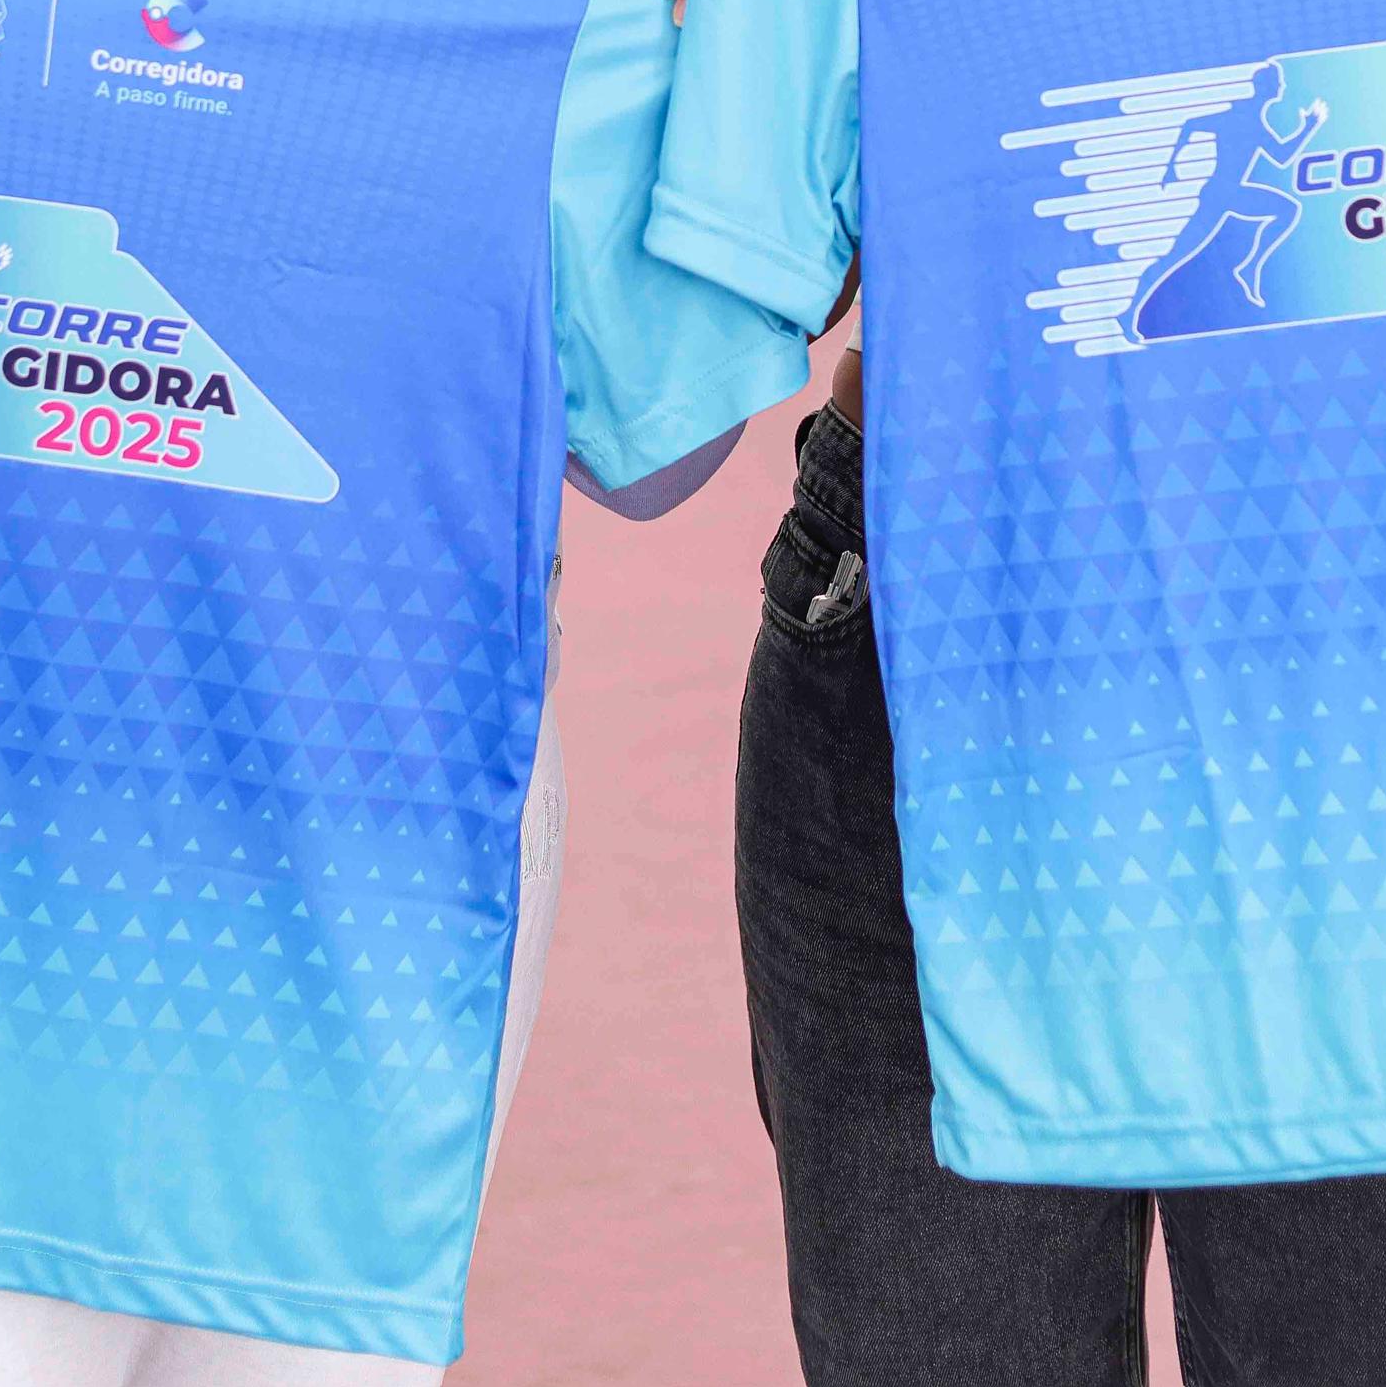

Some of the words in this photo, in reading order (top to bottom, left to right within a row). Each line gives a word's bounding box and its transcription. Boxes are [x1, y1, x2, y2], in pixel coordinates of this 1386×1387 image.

[91, 48, 245, 91] Corregidora
[94, 80, 111, 98] A
[116, 86, 168, 105] paso
[173, 89, 233, 116] firme.
[1, 347, 237, 415] GIDORA
[36, 400, 203, 469] 2025
